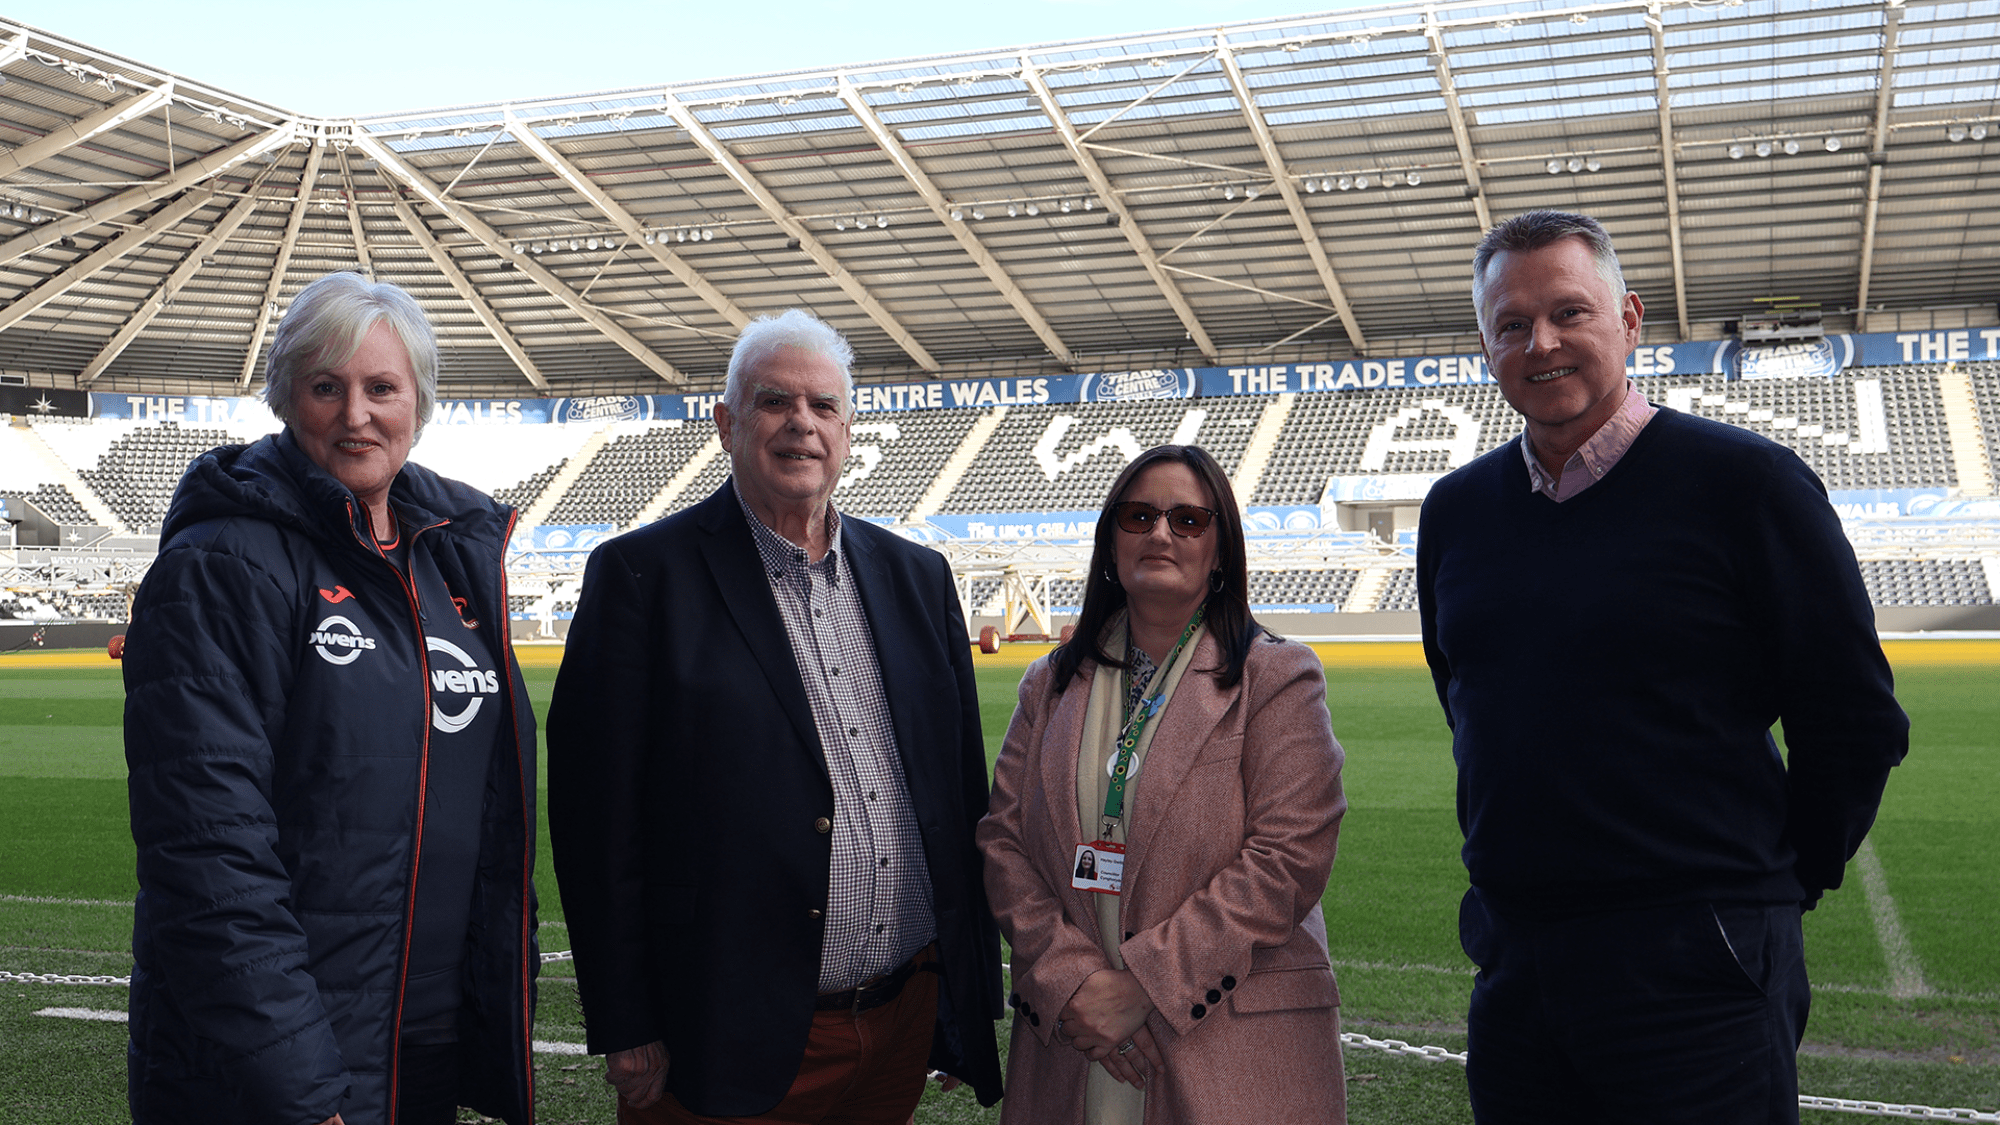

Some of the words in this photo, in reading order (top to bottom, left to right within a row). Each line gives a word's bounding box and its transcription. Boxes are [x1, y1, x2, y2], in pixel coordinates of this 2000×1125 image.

[1896, 331, 1970, 362] THE
[1108, 369, 1165, 385] TRADE
[1228, 366, 1287, 393] THE
[1295, 360, 1406, 391] TRADE
[1414, 356, 1497, 385] CEN
[950, 378, 1050, 406] WALES
[1114, 377, 1161, 396] CENTRE
[127, 396, 185, 422] THE
[193, 398, 250, 423] TRA
[577, 395, 627, 409] TRADE
[582, 403, 625, 419] CENTRE
[1036, 521, 1097, 538] CHEAPE
